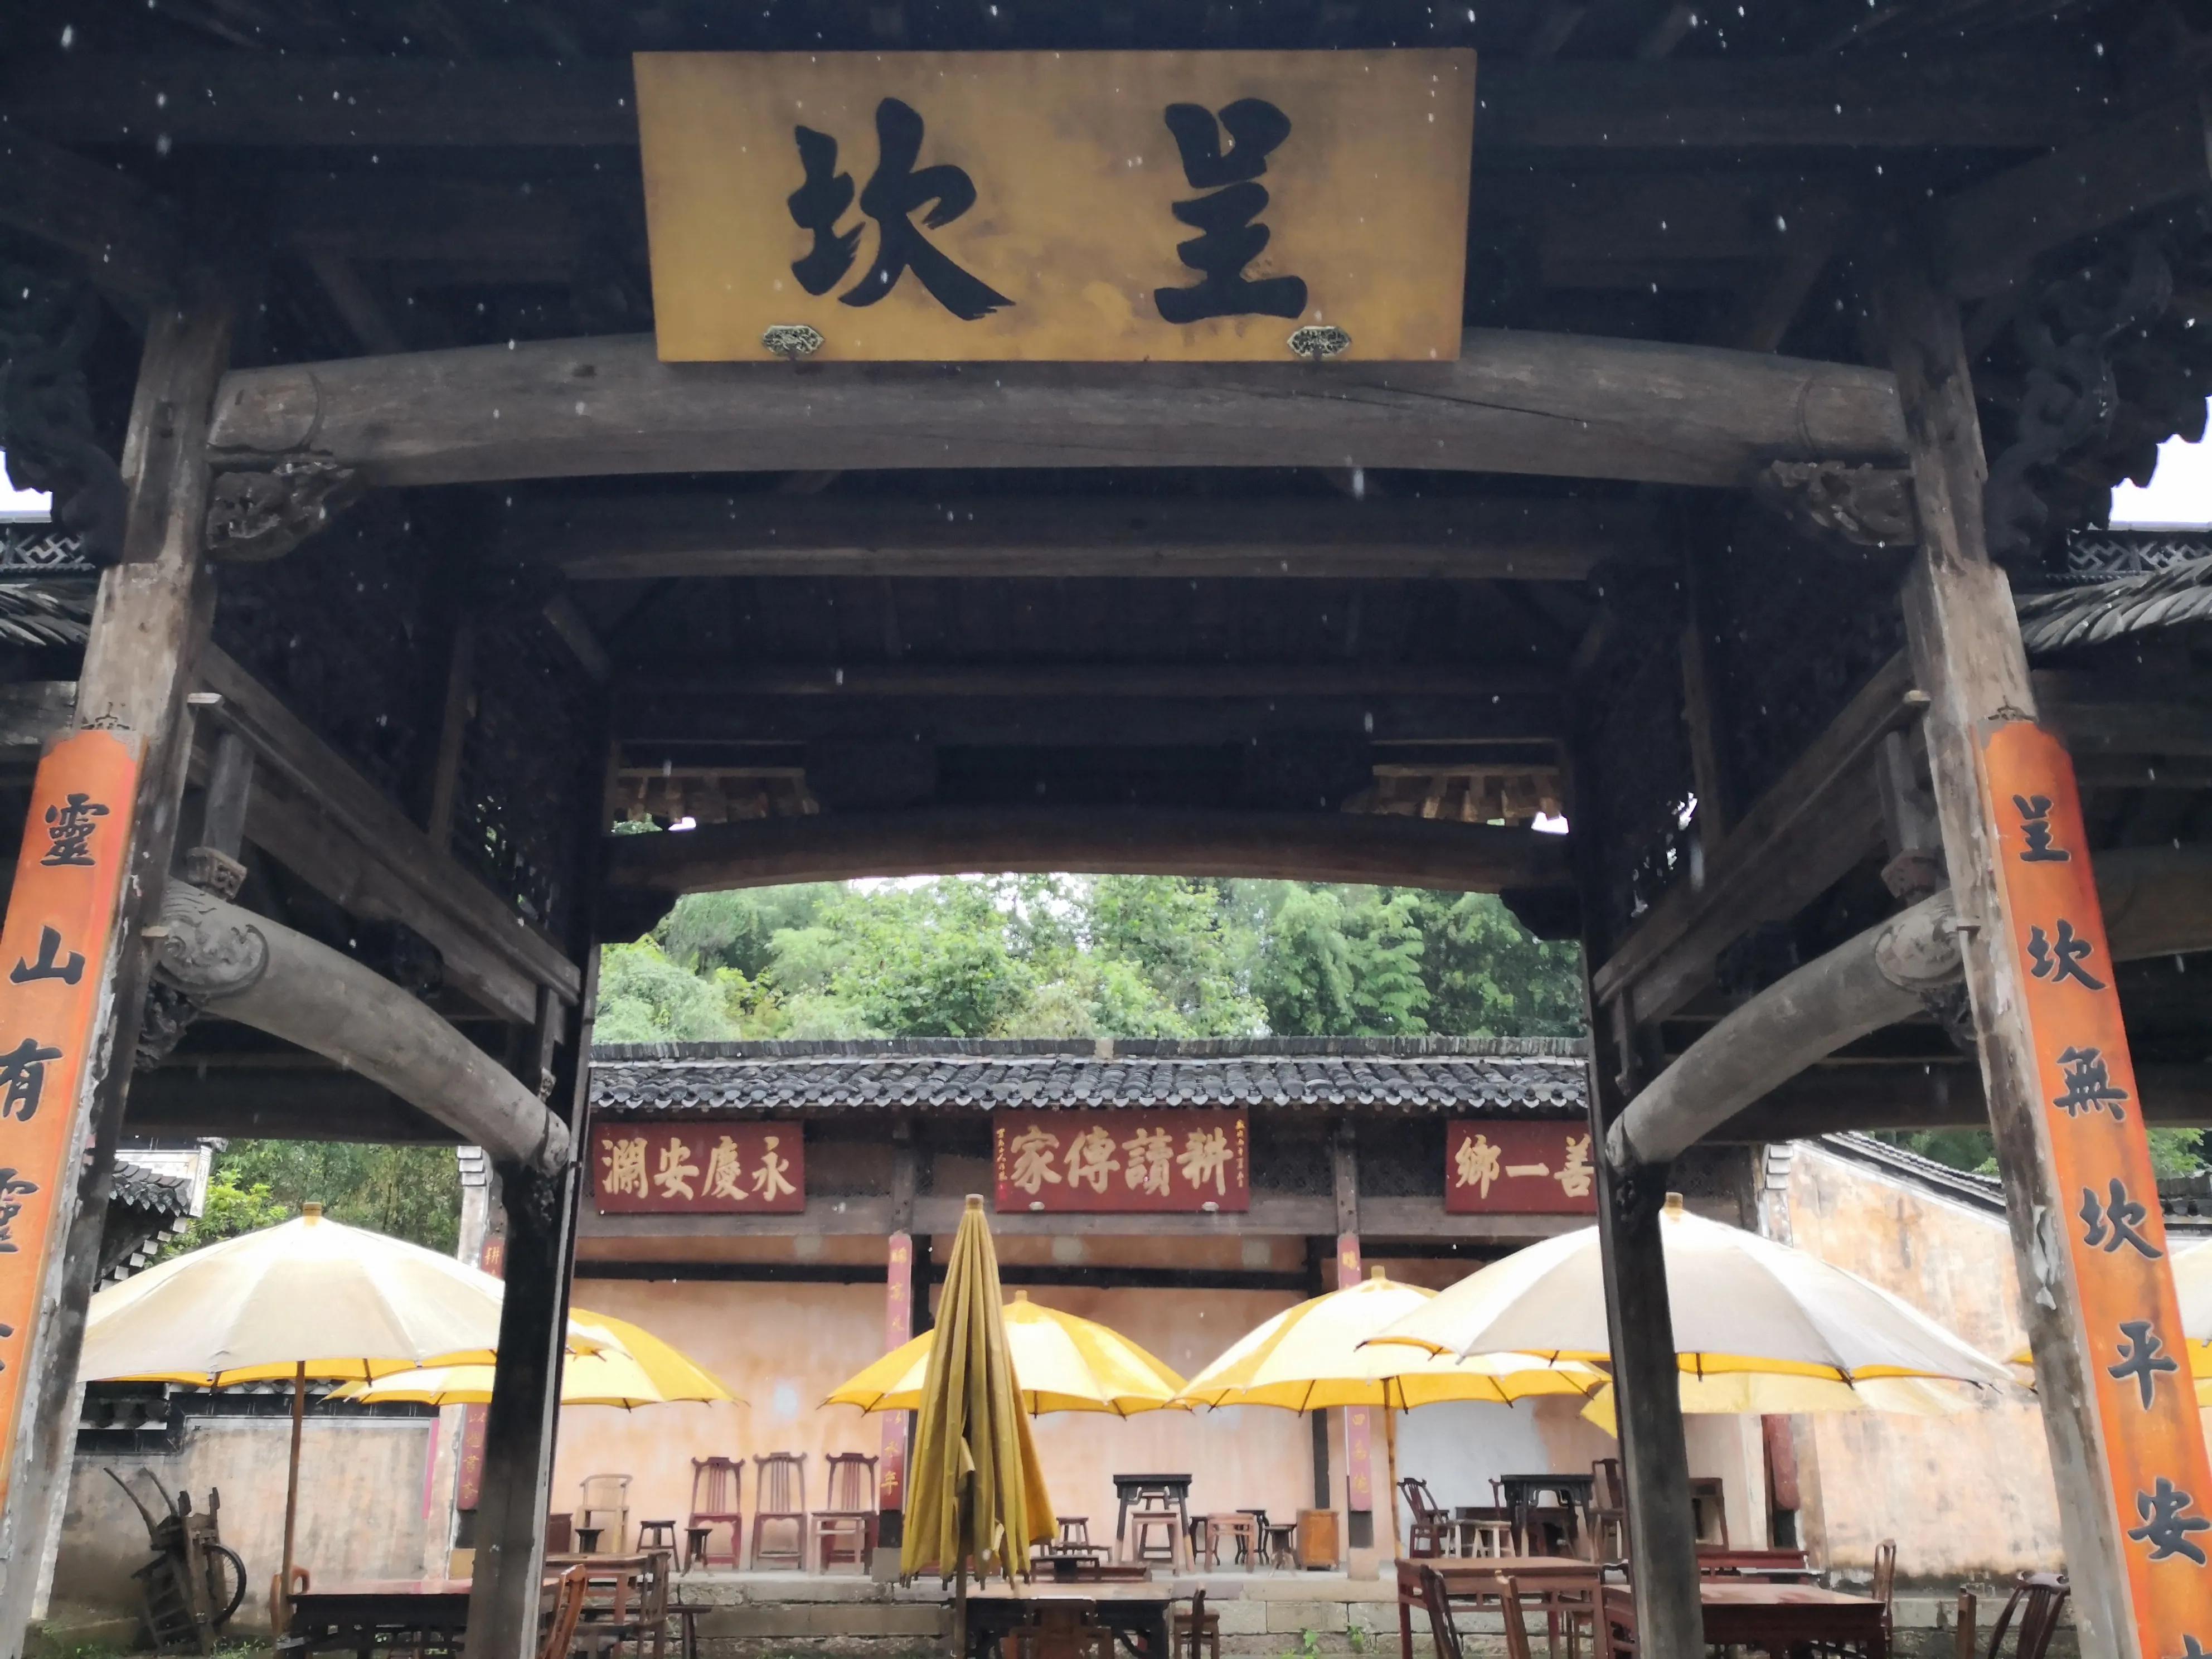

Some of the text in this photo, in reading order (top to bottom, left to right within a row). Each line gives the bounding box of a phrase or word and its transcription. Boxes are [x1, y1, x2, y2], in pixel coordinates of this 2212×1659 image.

[0, 793, 110, 1372] 靈山有靈
[2013, 793, 2211, 1659] 呈坎無坎平安
